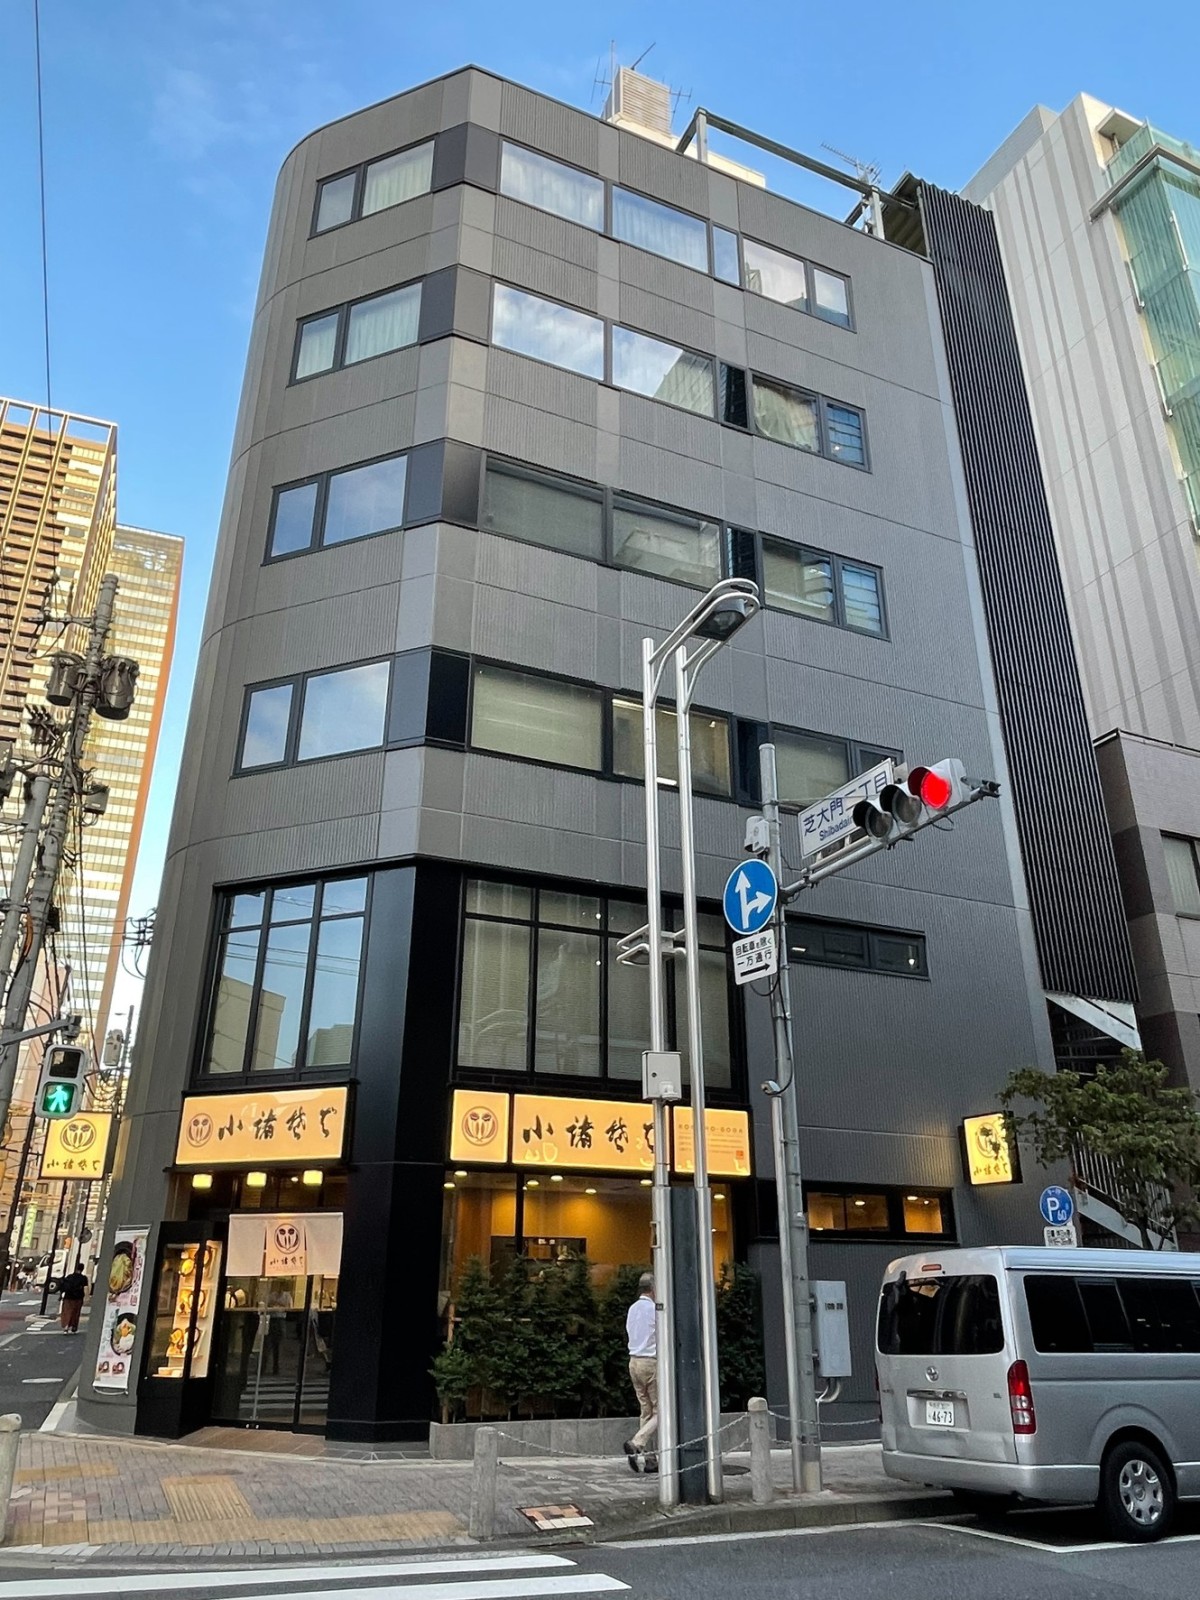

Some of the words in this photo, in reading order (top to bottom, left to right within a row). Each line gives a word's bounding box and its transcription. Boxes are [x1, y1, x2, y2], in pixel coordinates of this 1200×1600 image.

[803, 771, 887, 836] 芝大門二丁目
[819, 815, 853, 841] Shibadai
[737, 949, 772, 967] 一方通行
[1046, 1197, 1060, 1222] P
[932, 1410, 952, 1424] 46-73
